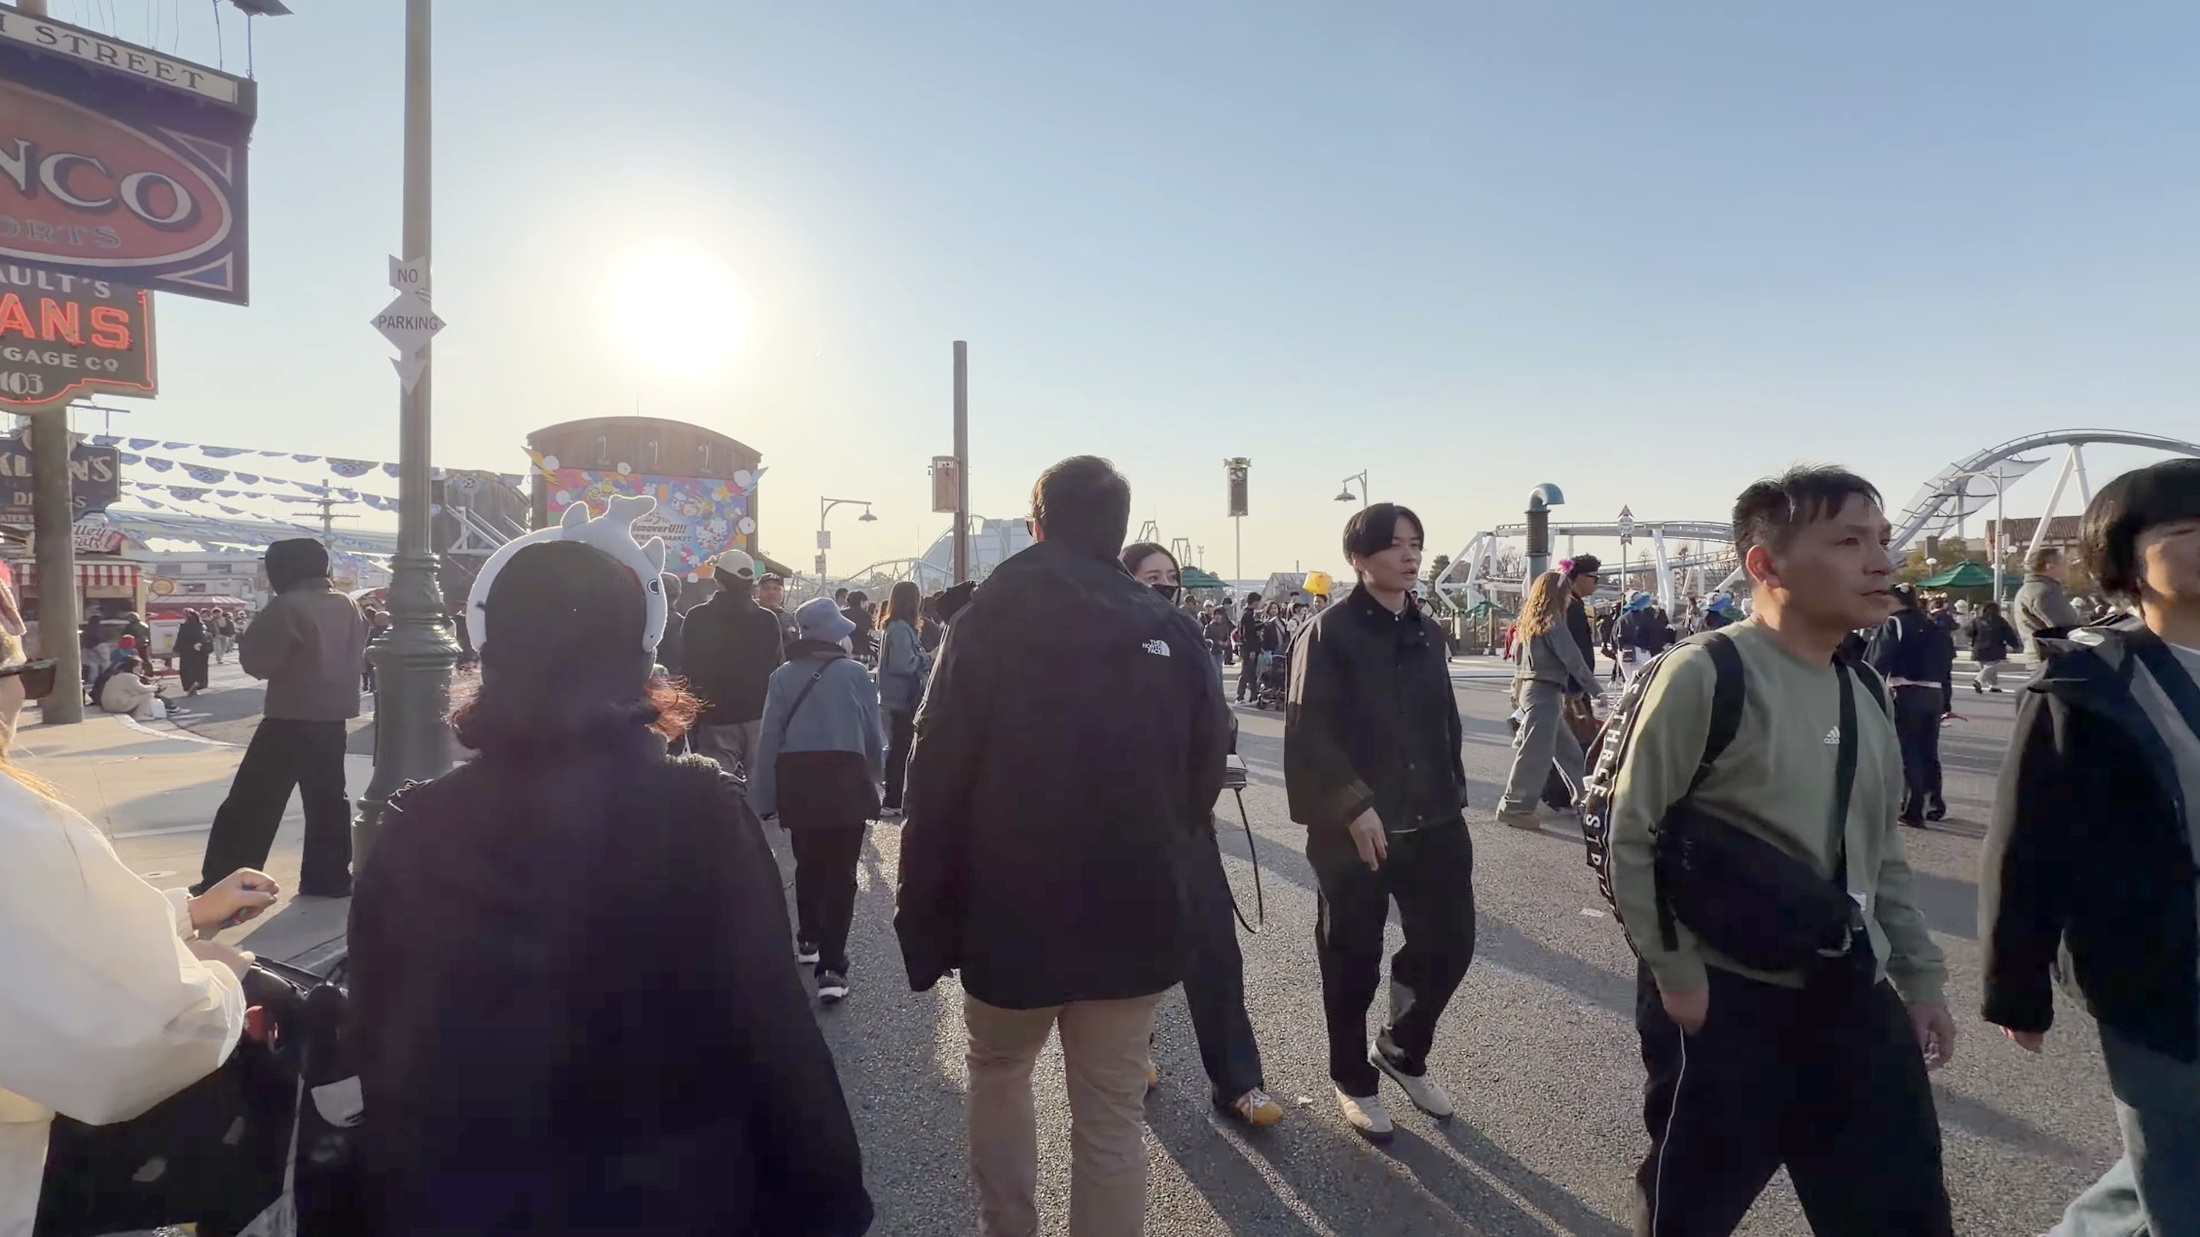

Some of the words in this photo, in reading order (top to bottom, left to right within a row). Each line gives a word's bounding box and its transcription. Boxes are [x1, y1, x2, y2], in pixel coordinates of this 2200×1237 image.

[35, 25, 204, 90] STREET
[398, 269, 418, 283] NO
[0, 292, 131, 350] ANS
[378, 315, 439, 331] PARKING
[0, 345, 78, 369] GAGE
